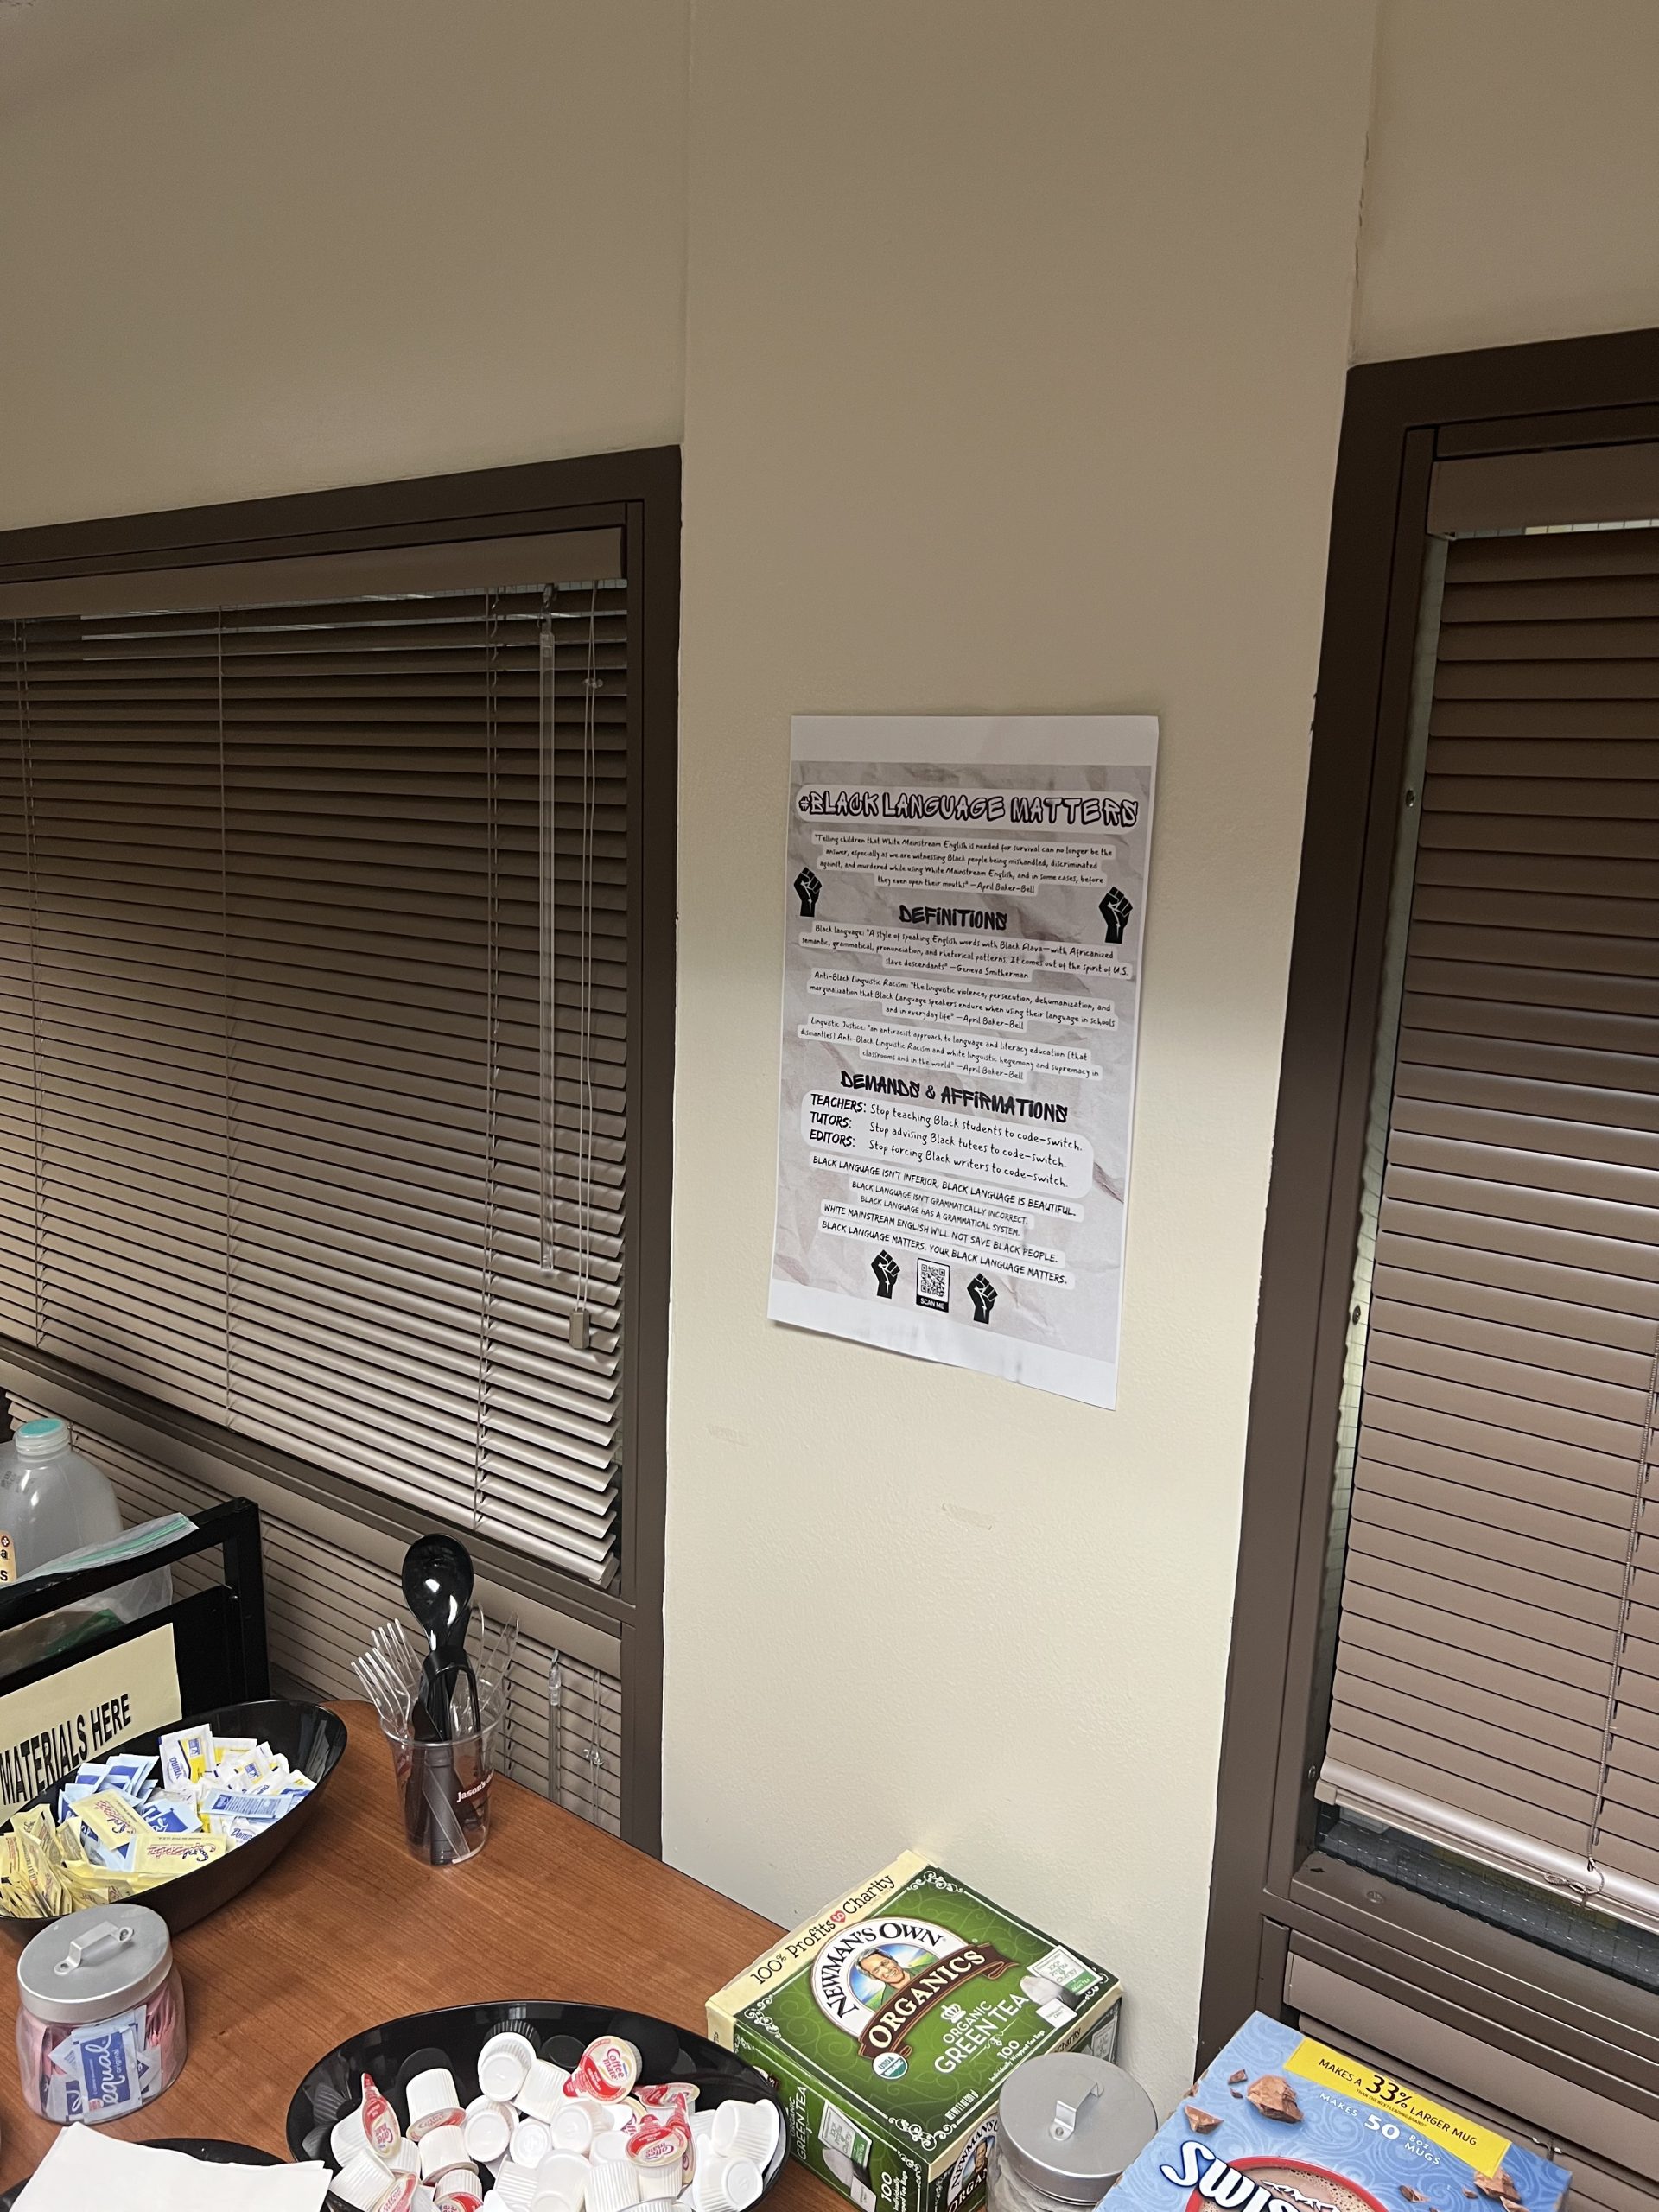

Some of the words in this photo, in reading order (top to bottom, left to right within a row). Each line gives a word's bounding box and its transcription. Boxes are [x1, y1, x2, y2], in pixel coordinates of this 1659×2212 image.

[798, 790, 880, 817] #BLACK
[881, 791, 1006, 823] LANGUAGE
[1009, 796, 1139, 828] MATTERS
[840, 836, 866, 844] children
[867, 836, 880, 845] that
[881, 837, 900, 846] White
[901, 838, 942, 848] Mainstream
[943, 840, 968, 852] English
[1001, 843, 1012, 853] for
[1013, 844, 1040, 853] survival
[1065, 846, 1089, 859] longer
[1090, 847, 1099, 855] be
[1100, 847, 1113, 856] the
[898, 904, 1007, 931] DEFINITIONS
[810, 1093, 867, 1114] TEACHERS:
[870, 1103, 890, 1121] Stop
[893, 1107, 931, 1128] teaching
[933, 1114, 959, 1128] Black
[962, 1120, 1002, 1136] students
[1005, 1127, 1014, 1138] to
[840, 1070, 920, 1099] DEMANDS
[925, 1084, 936, 1100] &
[940, 1085, 1068, 1123] AFFIRMATIONS
[810, 1110, 852, 1129] TUTORS:
[869, 1122, 889, 1138] Stop
[892, 1127, 928, 1146] advising
[930, 1132, 955, 1146] Black
[958, 1137, 988, 1154] tutees
[990, 1143, 1000, 1154] to
[810, 1128, 855, 1147] EDITORS:
[868, 1139, 888, 1156] Stop
[891, 1145, 924, 1163] forcing
[925, 1149, 950, 1164] Black
[953, 1158, 989, 1173] writers
[992, 1162, 1001, 1173] to
[812, 1155, 837, 1168] BLACK
[838, 1160, 880, 1176] LANGUAGE
[881, 1168, 902, 1180] ISN'T
[903, 1173, 939, 1189] INFERIOR.
[942, 1180, 969, 1195] BLACK
[970, 1187, 1015, 1204] LANGUAGE
[1017, 1197, 1026, 1206] IS
[1027, 1198, 1077, 1217] BEAUTIFUL.
[852, 1180, 874, 1192] BLACK
[874, 1185, 912, 1199] LANGUAGE
[912, 1193, 930, 1204] ISN'T
[931, 1198, 987, 1216] GRAMMATICALLY
[988, 1210, 1028, 1225] INCORRECT.
[824, 1204, 846, 1215] WHITE
[848, 1208, 895, 1226] MAINSTREAM
[896, 1218, 930, 1234] ENGLISH
[931, 1226, 950, 1238] WILL
[951, 1231, 969, 1243] NOT
[969, 1236, 991, 1248] SAVE
[993, 1240, 1021, 1255] BLACK
[1022, 1247, 1058, 1263] PEOPLE.
[860, 1195, 883, 1206] BLACK
[883, 1200, 919, 1214] LANGUAGE
[920, 1208, 934, 1217] HAS
[935, 1211, 941, 1219] A
[942, 1213, 991, 1230] GRAMMATICAL
[992, 1224, 1020, 1236] SYSTEM.
[822, 1220, 848, 1233] BLACK
[848, 1226, 890, 1242] LANGUAGE
[892, 1235, 927, 1251] MATTERS.
[929, 1244, 950, 1258] YOUR
[950, 1249, 978, 1263] BLACK
[980, 1256, 1026, 1274] LANGUAGE
[1027, 1268, 1067, 1285] MATTERS.
[920, 1297, 936, 1307] SCAN
[0, 1714, 88, 1806] MATERIALS
[91, 1693, 131, 1751] HERE
[456, 1779, 486, 1803] Jason's
[750, 1953, 787, 1985] 100%
[785, 1920, 836, 1959] Profits
[842, 1874, 896, 1915] Charity
[822, 1927, 877, 2019] NEWMAN'S
[879, 1922, 943, 1947] OWN
[868, 1949, 987, 2049] ORGANICS
[934, 2018, 999, 2074] GREEN
[987, 1993, 1030, 2023] TEA
[943, 2000, 992, 2044] ORGANIC
[607, 2048, 626, 2078] Coffee
[877, 2056, 895, 2070] USDA
[997, 2039, 1020, 2060] 100
[796, 2085, 807, 2115] TEA
[1319, 2057, 1354, 2082] MAKES
[1353, 2077, 1363, 2088] A
[1364, 2074, 1414, 2109] 33%
[1409, 2106, 1451, 2133] LARGER
[1452, 2126, 1478, 2146] MUG
[1319, 2092, 1359, 2118] MAKES
[1363, 2113, 1401, 2140] 50
[645, 2145, 675, 2159] Coffee
[795, 2114, 807, 2160] GREEN
[1404, 2141, 1441, 2166] MUGS
[880, 2171, 893, 2202] 100
